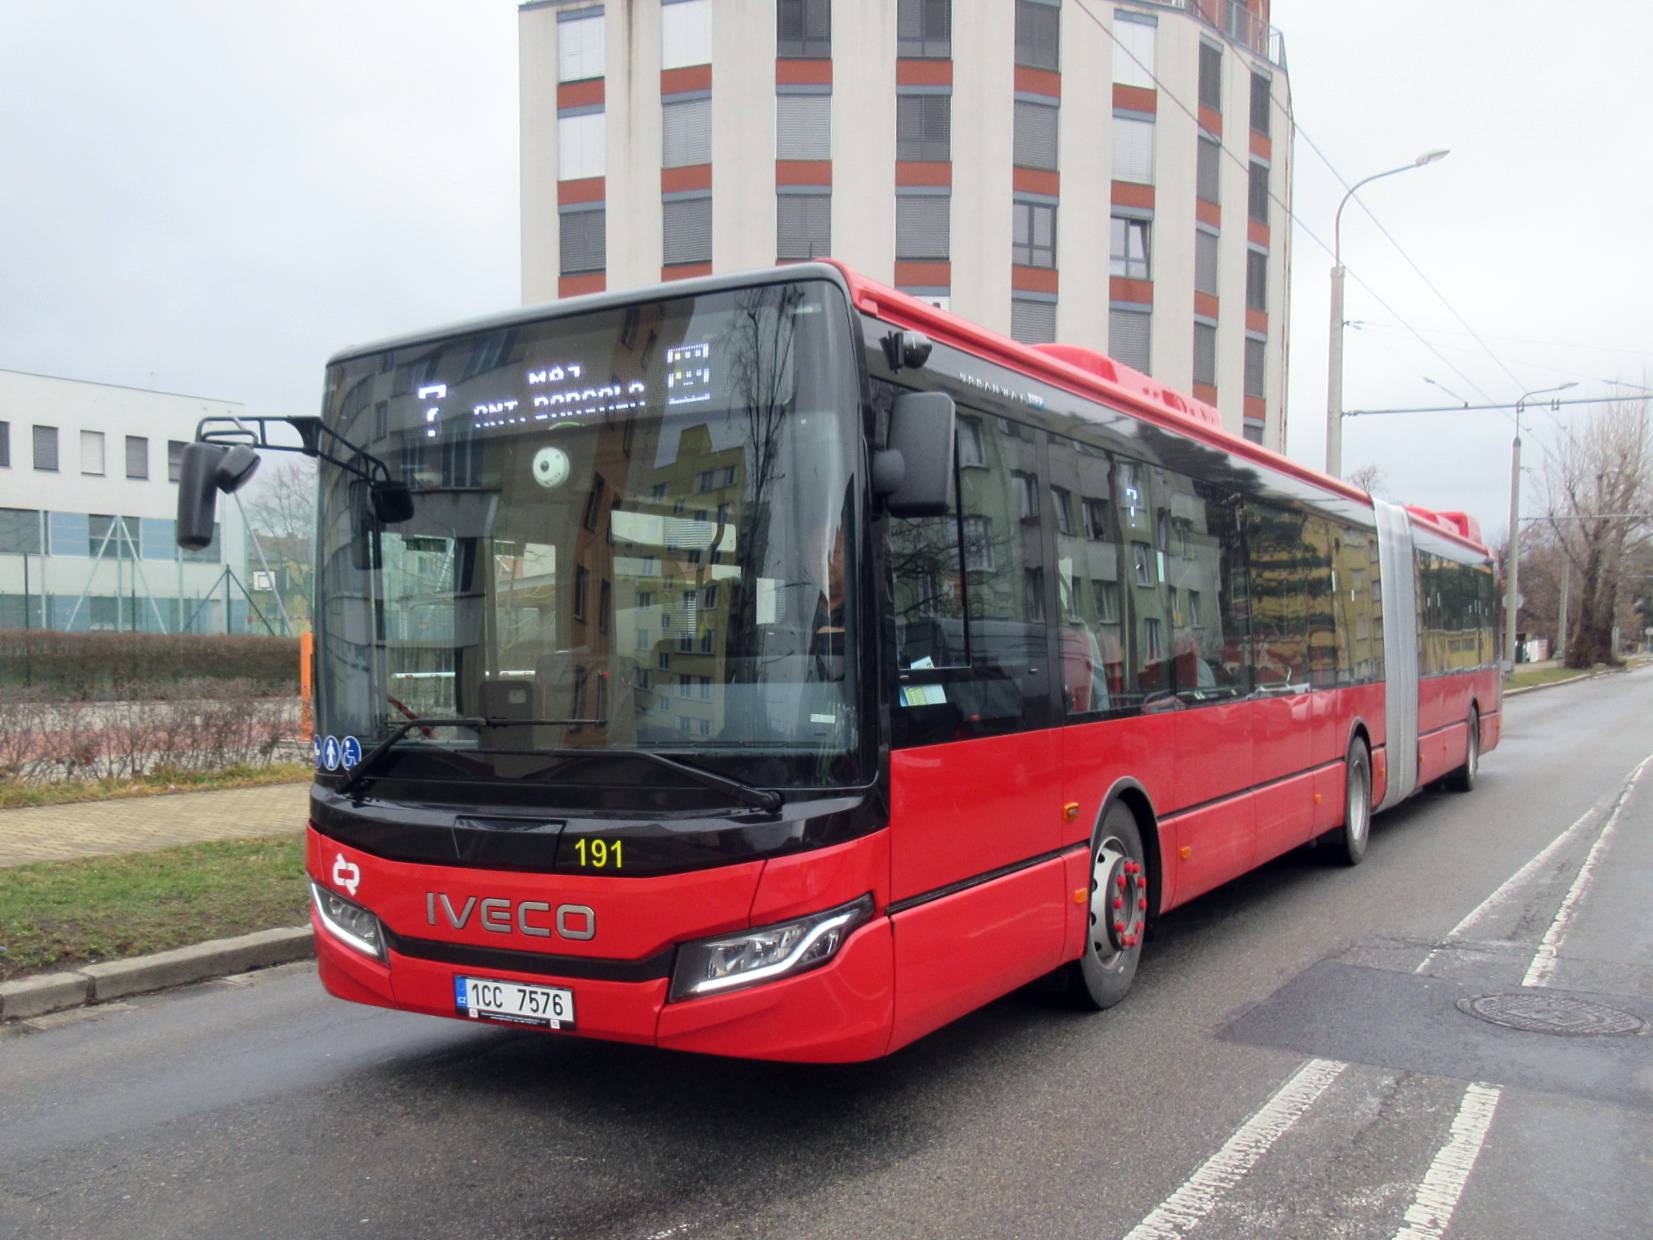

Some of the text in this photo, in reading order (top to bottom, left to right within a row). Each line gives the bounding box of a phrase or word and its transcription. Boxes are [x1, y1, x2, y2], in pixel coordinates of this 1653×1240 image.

[574, 838, 623, 869] 191
[425, 891, 596, 942] IVECO
[457, 996, 467, 1004] CZ
[471, 983, 564, 1017] 1CC 7576
